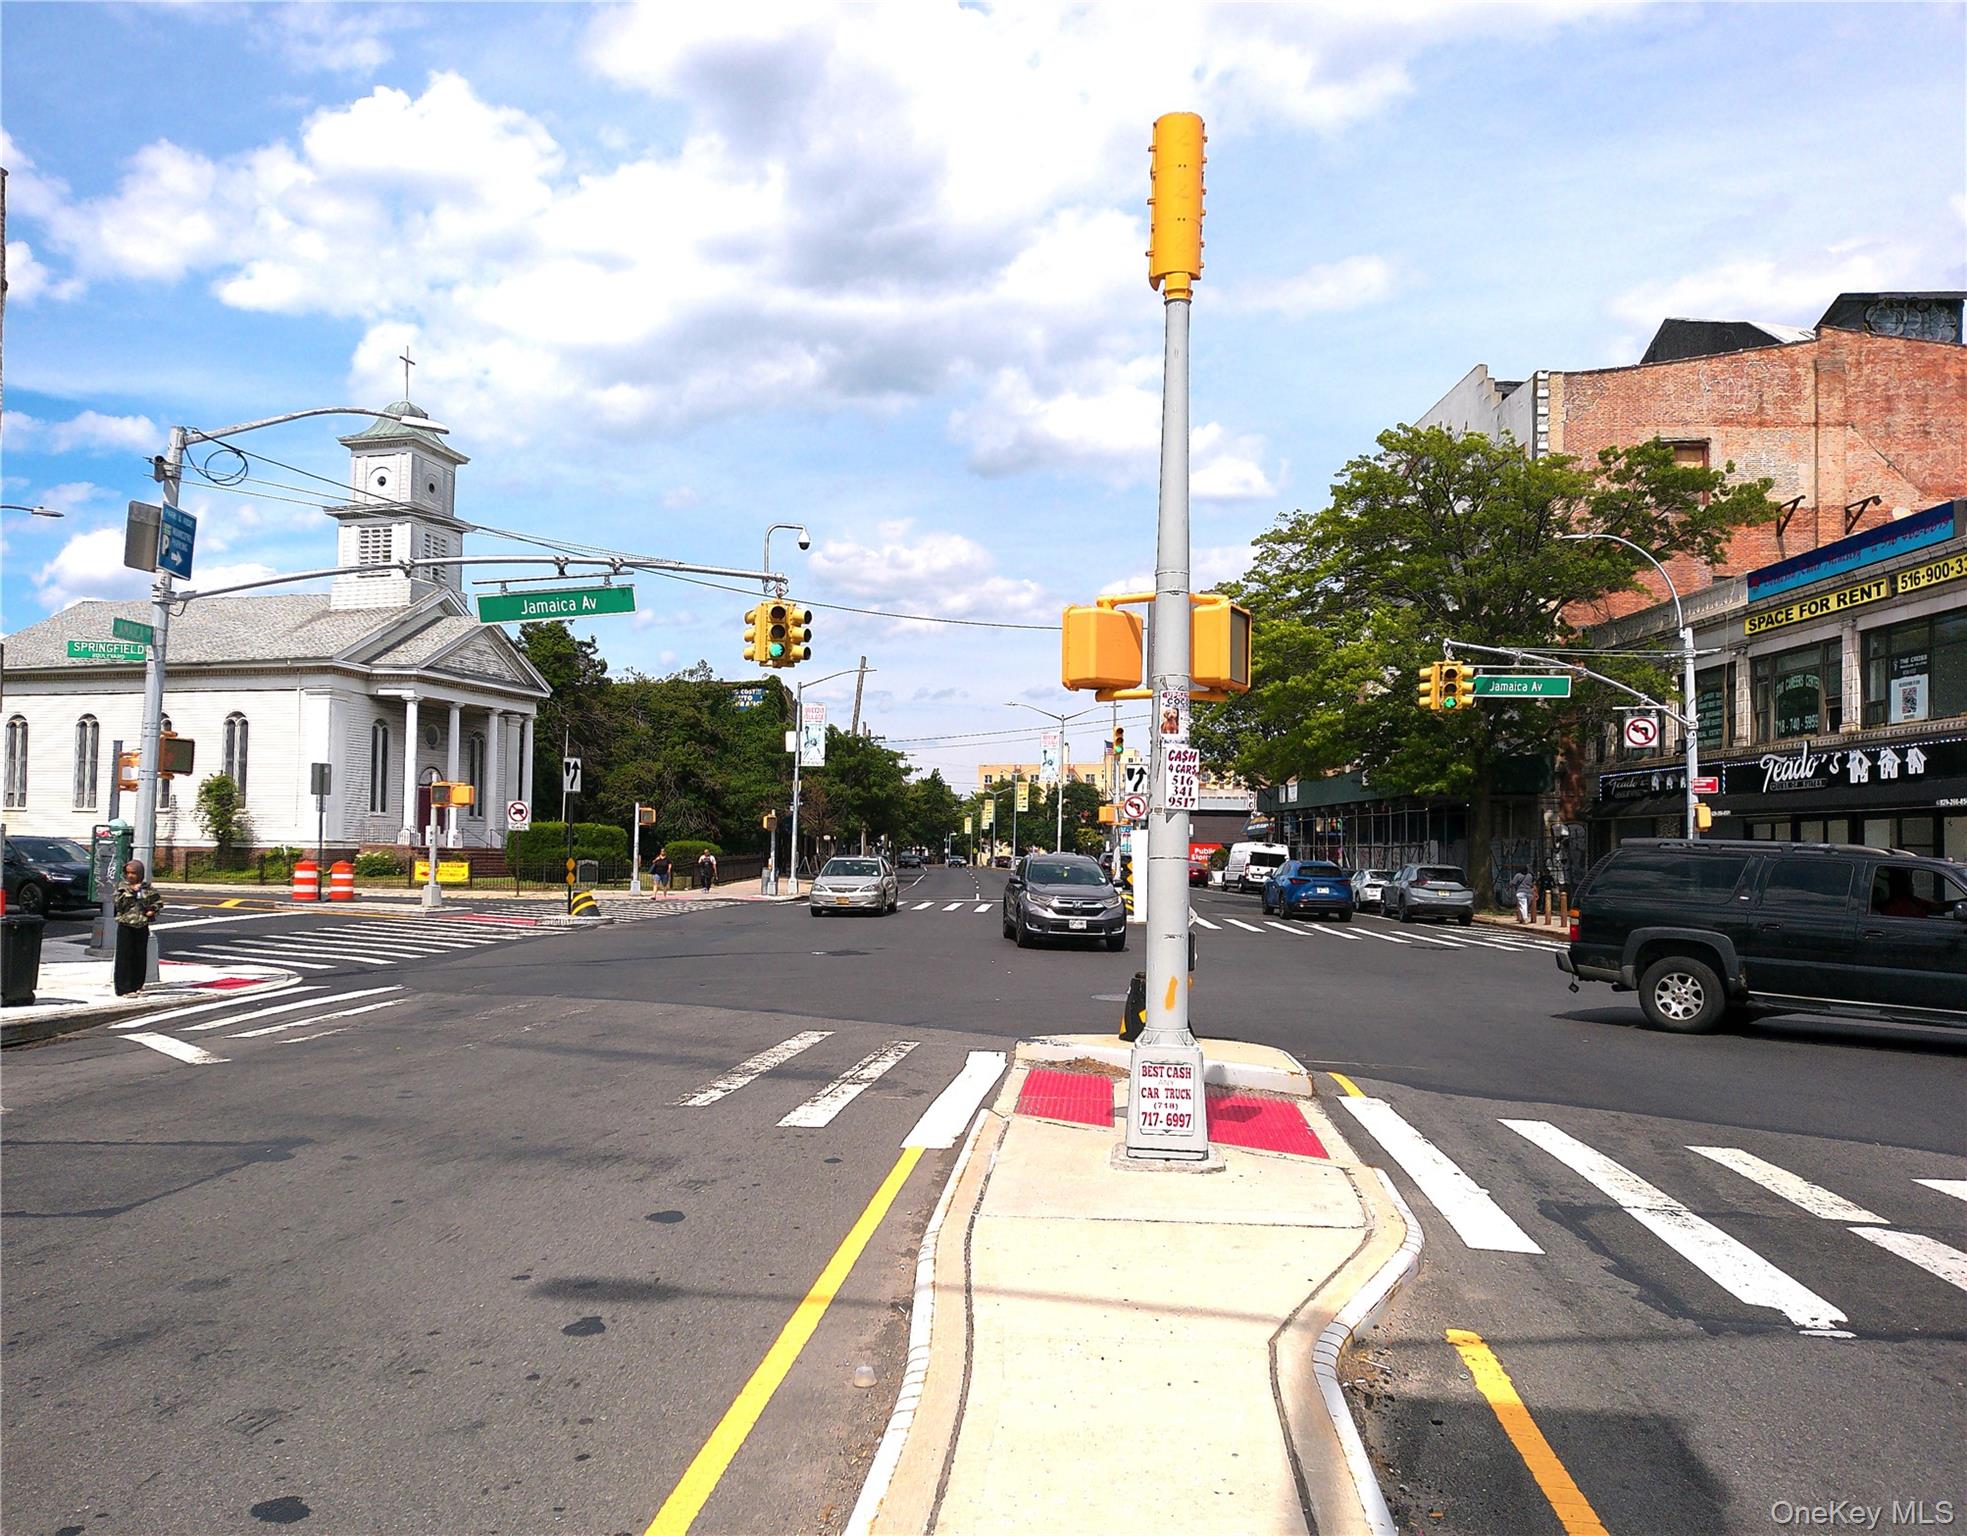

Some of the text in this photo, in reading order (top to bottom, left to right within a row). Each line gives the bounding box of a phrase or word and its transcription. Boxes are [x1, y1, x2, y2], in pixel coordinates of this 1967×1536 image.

[521, 595, 597, 615] Jamaica Av
[1748, 581, 1885, 631] SPACE FOR RENT
[74, 642, 144, 654] SPRINGFIELD
[1489, 681, 1543, 692] Jamaica Av
[1760, 740, 1842, 793] Teado's
[1172, 775, 1193, 785] 516
[1172, 786, 1192, 796] 341
[1168, 797, 1196, 807] 9517
[1142, 1066, 1191, 1079] BEST CASH
[1141, 1087, 1191, 1100] CAR TRUCK
[1154, 1102, 1178, 1110] (718)
